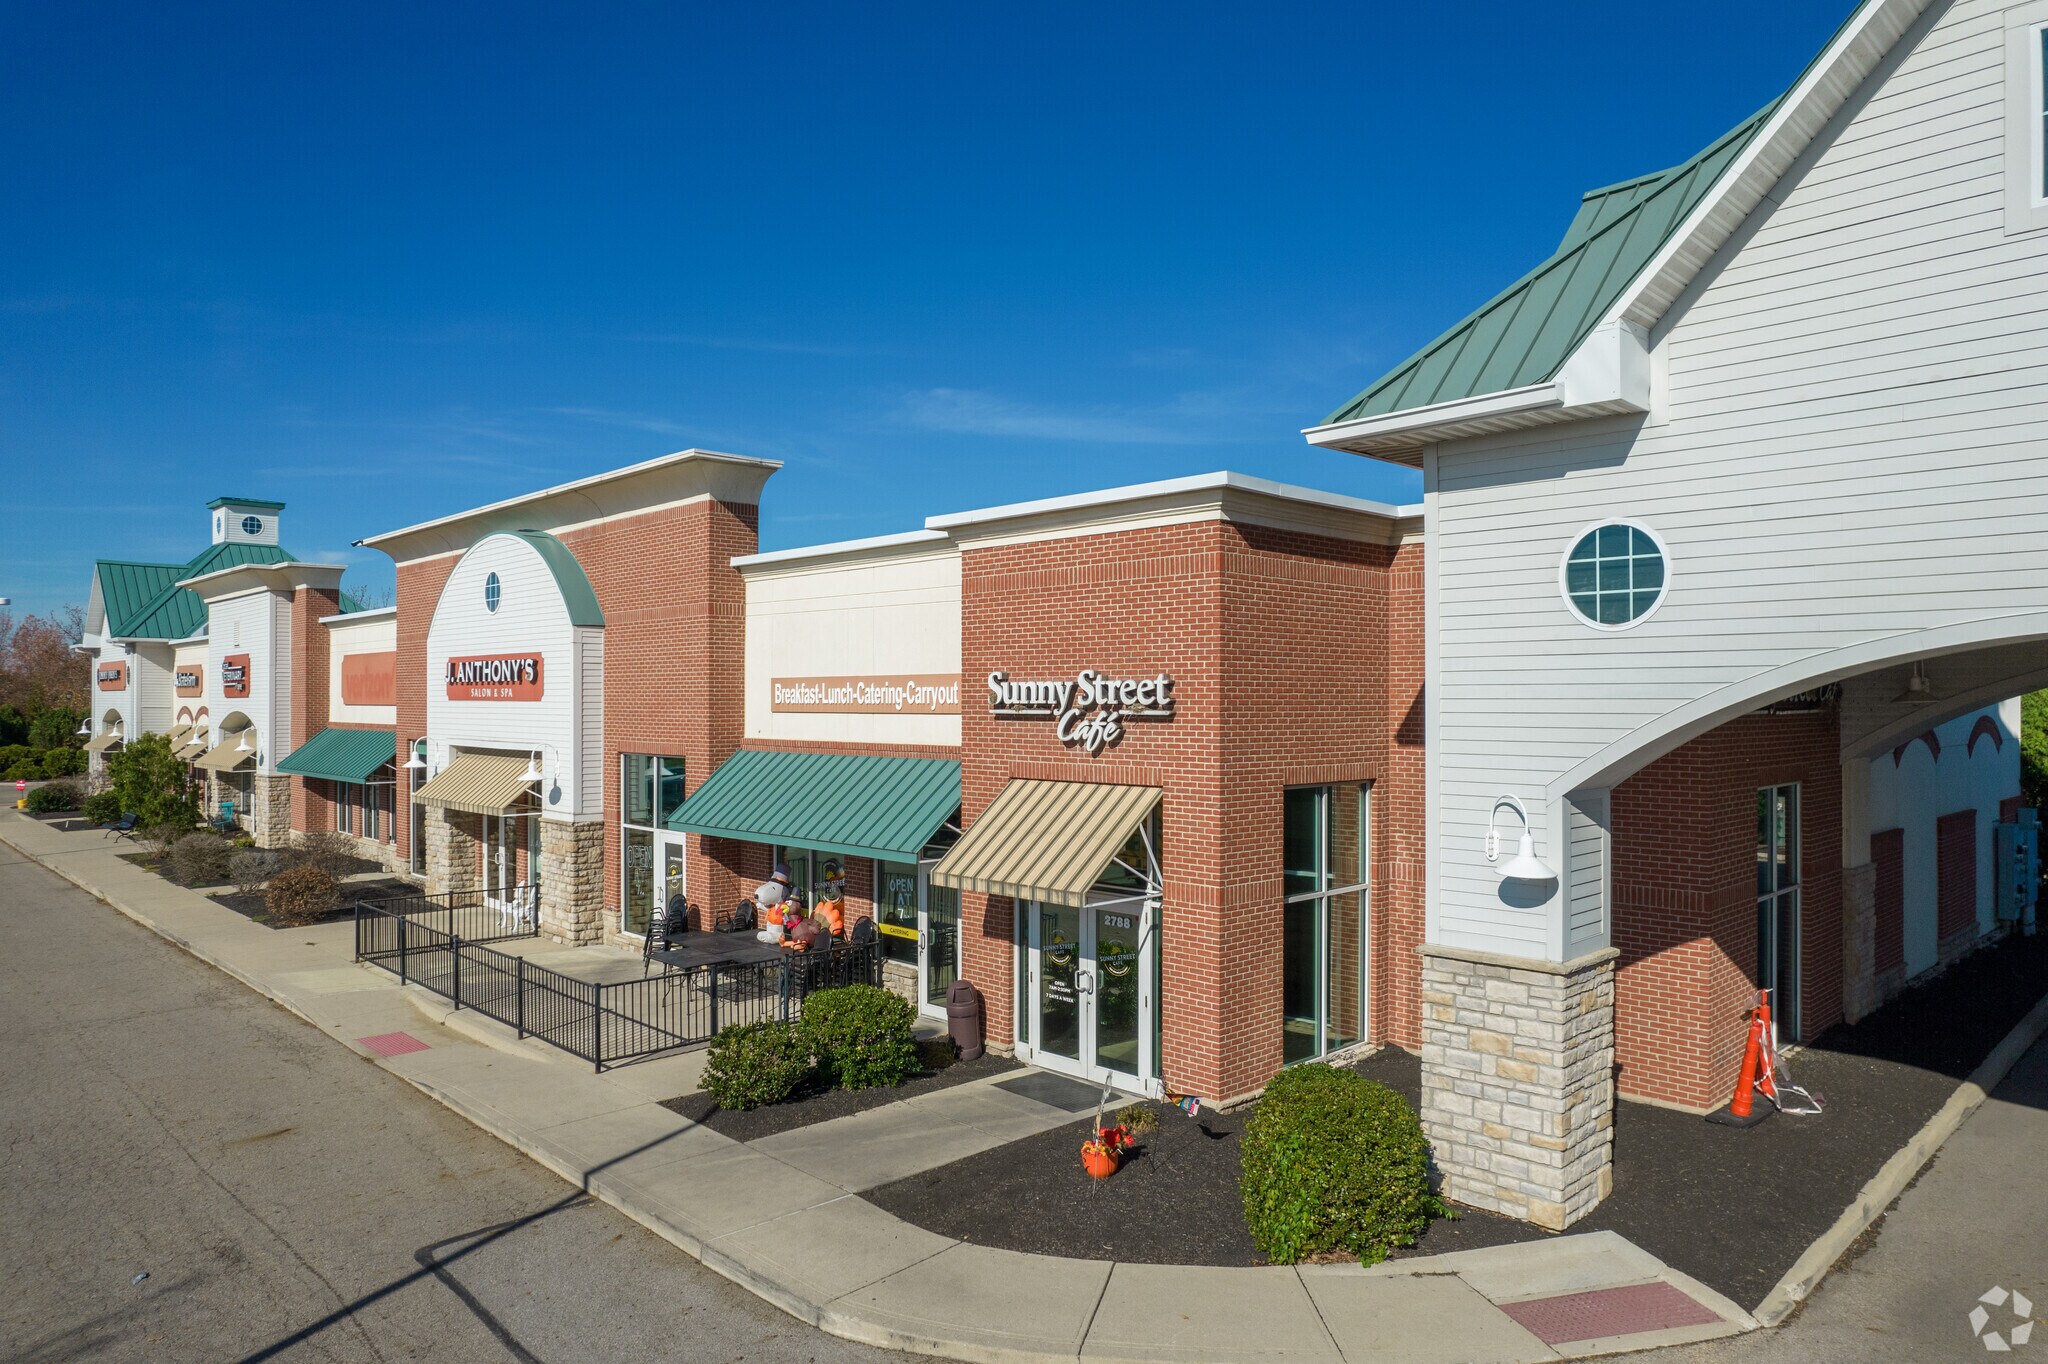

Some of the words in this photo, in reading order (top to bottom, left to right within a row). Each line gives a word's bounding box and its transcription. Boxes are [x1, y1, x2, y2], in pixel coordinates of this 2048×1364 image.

[456, 658, 534, 683] ANTHONY'S
[470, 688, 491, 698] SALON
[494, 688, 498, 698] &
[500, 688, 513, 697] SPA
[774, 681, 959, 710] Breakfast-Lunch-Catering-Carryout
[988, 671, 1075, 715] Sunny
[1077, 669, 1171, 706] Street
[1057, 708, 1121, 753] Café
[889, 878, 914, 892] OPEN
[897, 893, 911, 906] AT
[1104, 915, 1131, 929] 2788
[889, 928, 909, 936] CATERING
